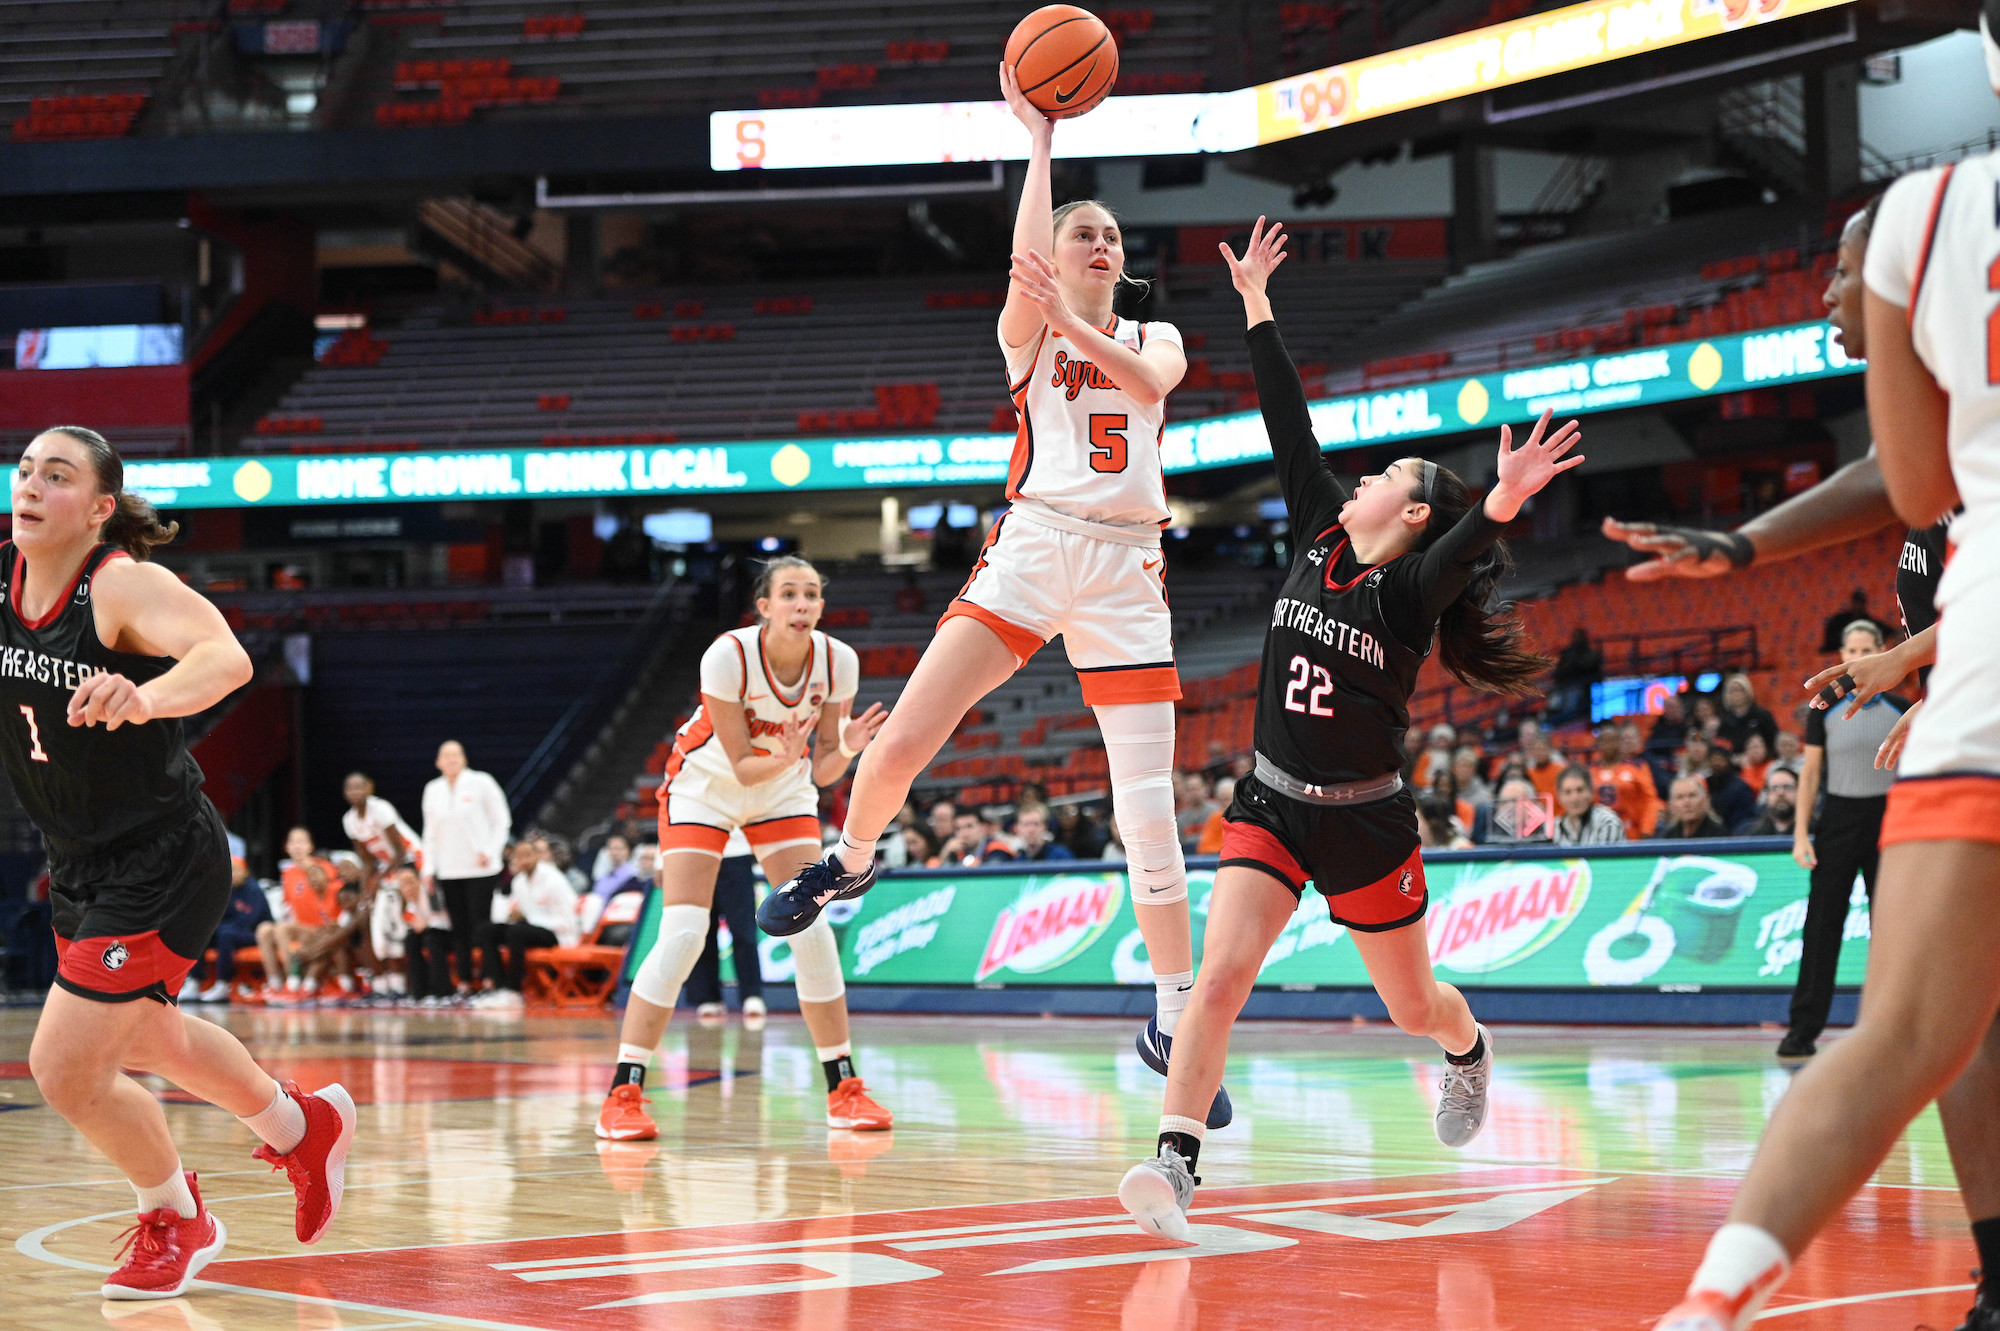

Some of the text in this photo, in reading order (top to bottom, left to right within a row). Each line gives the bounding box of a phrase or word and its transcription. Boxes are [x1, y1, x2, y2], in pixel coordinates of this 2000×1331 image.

[1051, 350, 1122, 402] Syra
[1742, 332, 1825, 382] HOME
[297, 446, 748, 499] HOME GROWN. DRINK LOCAL.
[1088, 413, 1128, 473] 5
[1271, 597, 1384, 671] ORTHEASTERN
[1284, 654, 1335, 718] 22
[19, 704, 49, 763] 1
[976, 881, 1116, 980] LIBMAN
